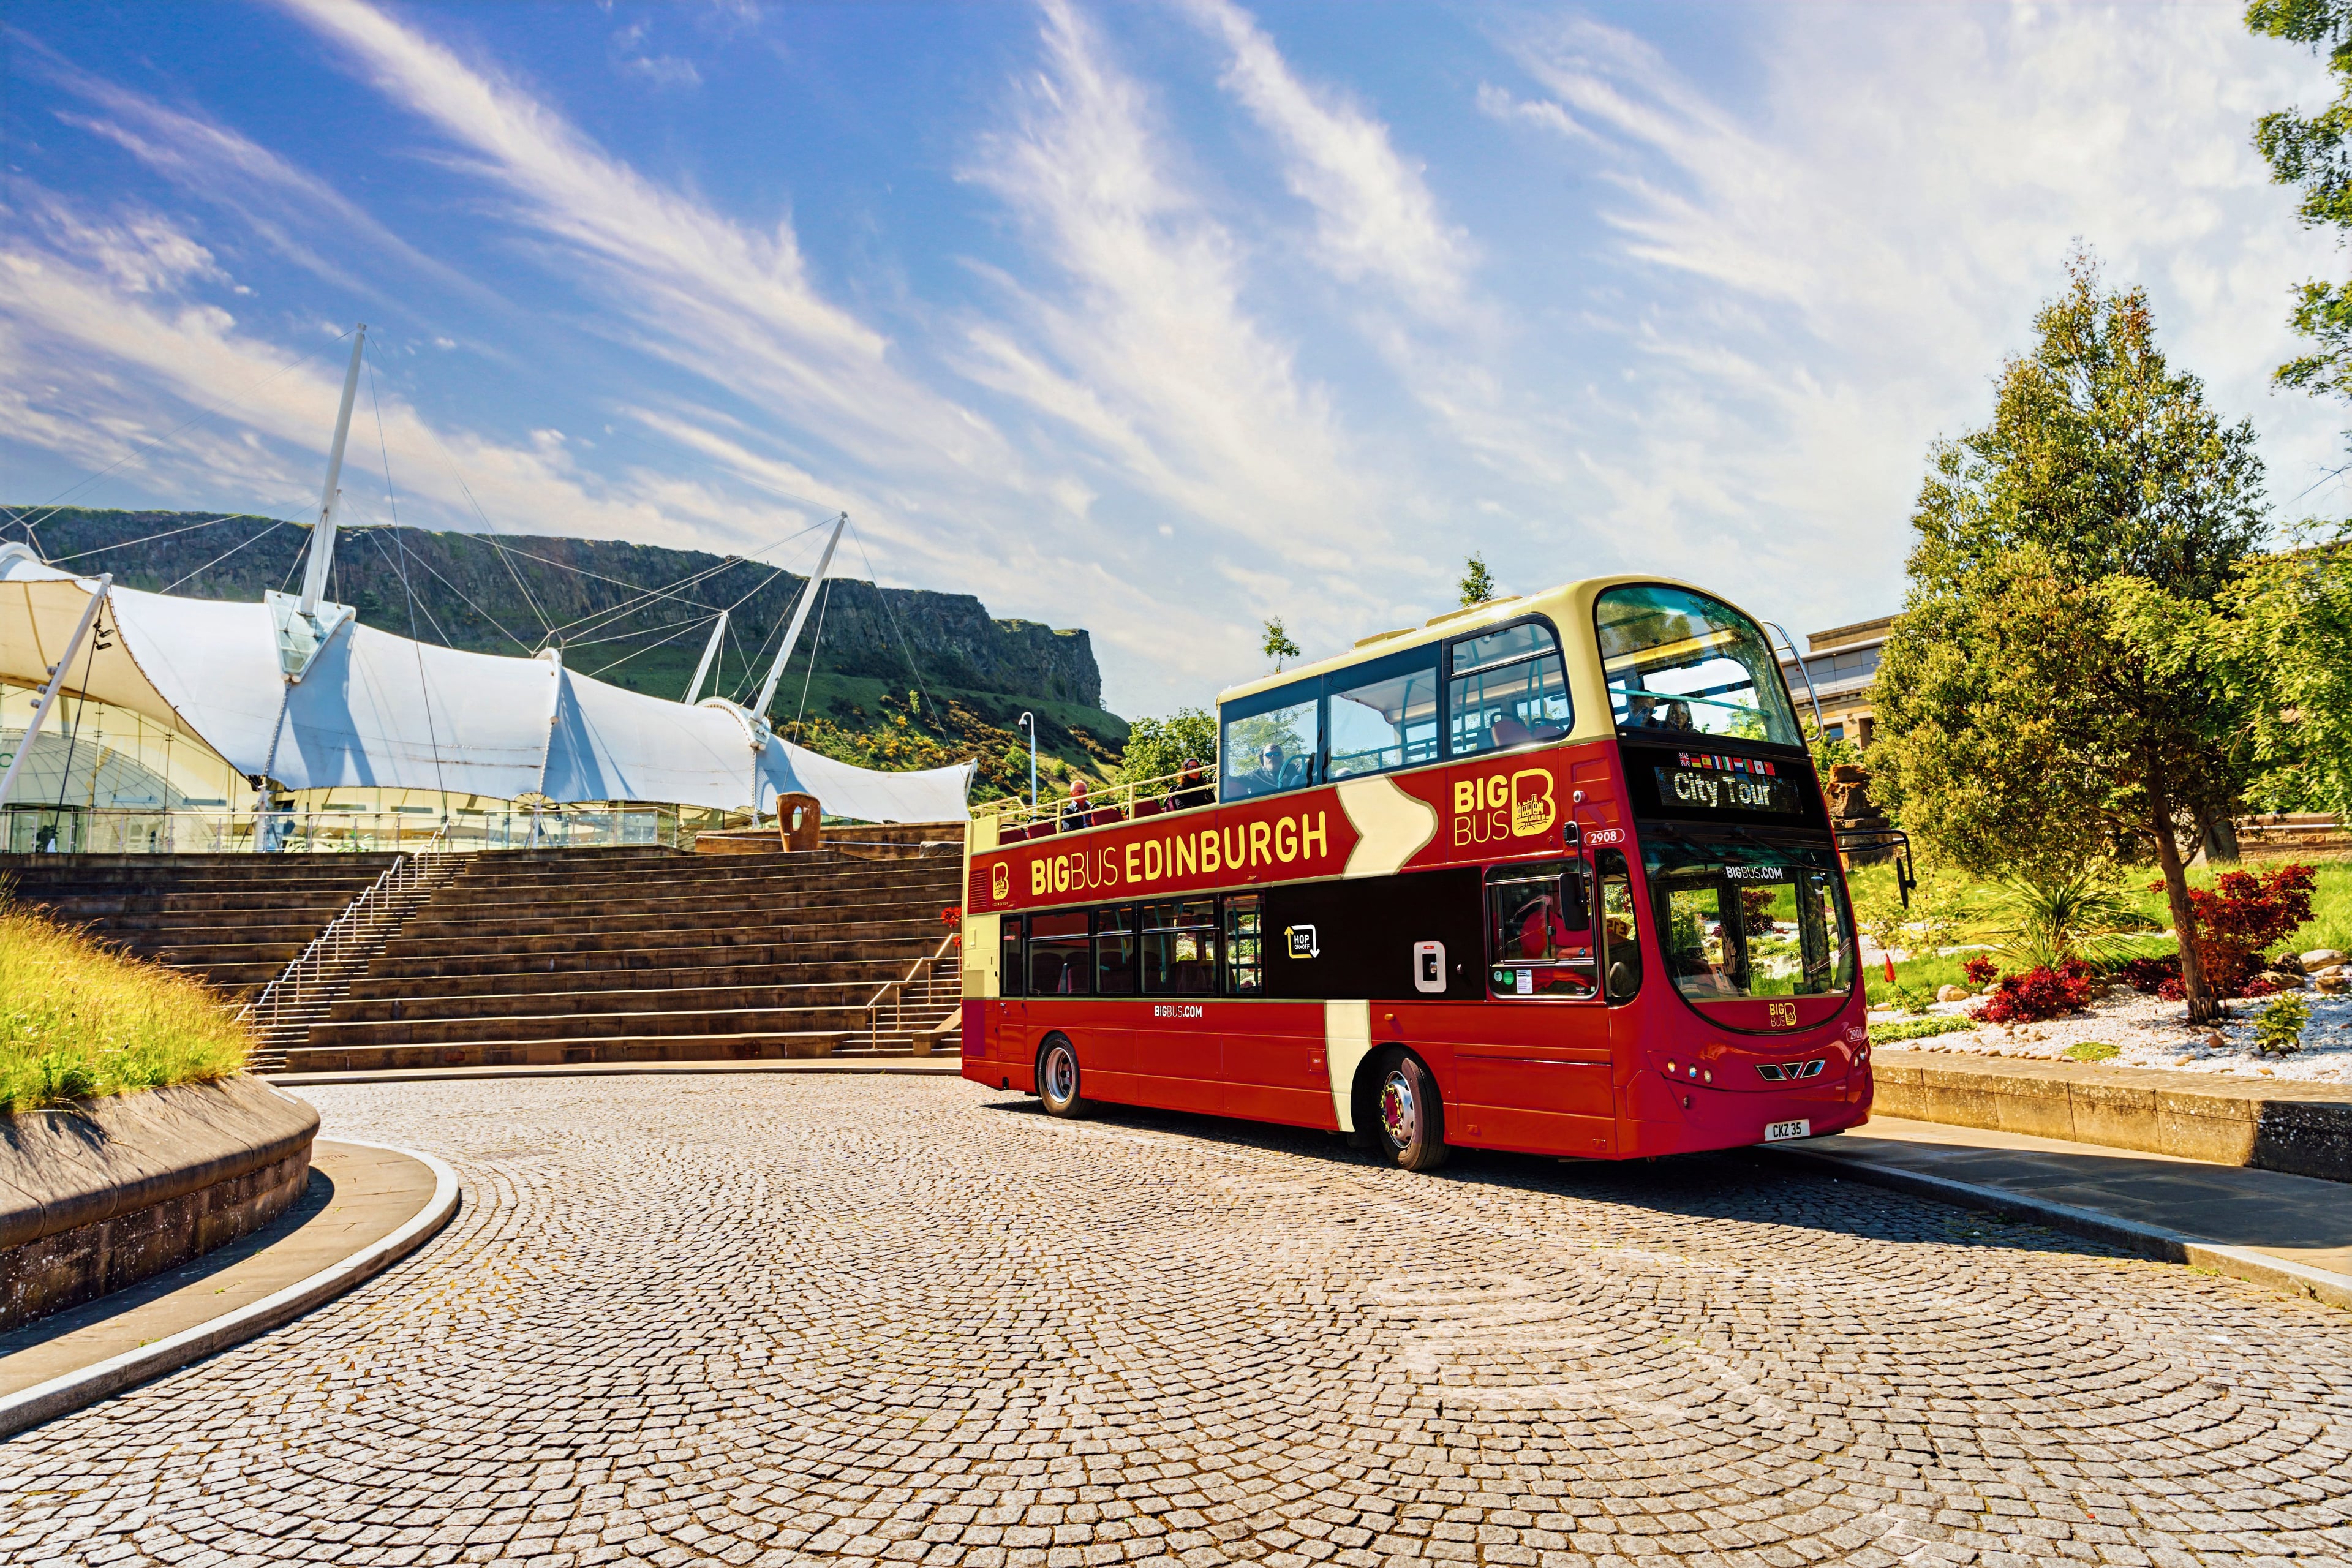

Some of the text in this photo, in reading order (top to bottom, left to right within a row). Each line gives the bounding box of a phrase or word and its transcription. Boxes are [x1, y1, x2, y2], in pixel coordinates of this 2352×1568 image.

[1454, 775, 1508, 814] BIG
[1674, 772, 1770, 807] City Tour
[1455, 810, 1509, 846] BUS
[1591, 831, 1617, 843] 2908
[1031, 810, 1327, 895] BIGBUS EDINBURGH
[1725, 866, 1783, 879] BIGBUS.COM
[1294, 934, 1310, 944] HOP
[1155, 1005, 1202, 1017] BIGBUS.COM
[1769, 1003, 1784, 1016] BIG
[1771, 1016, 1785, 1027] BUS
[1849, 1028, 1863, 1039] 2908
[1773, 1122, 1801, 1137] CKZ 35
